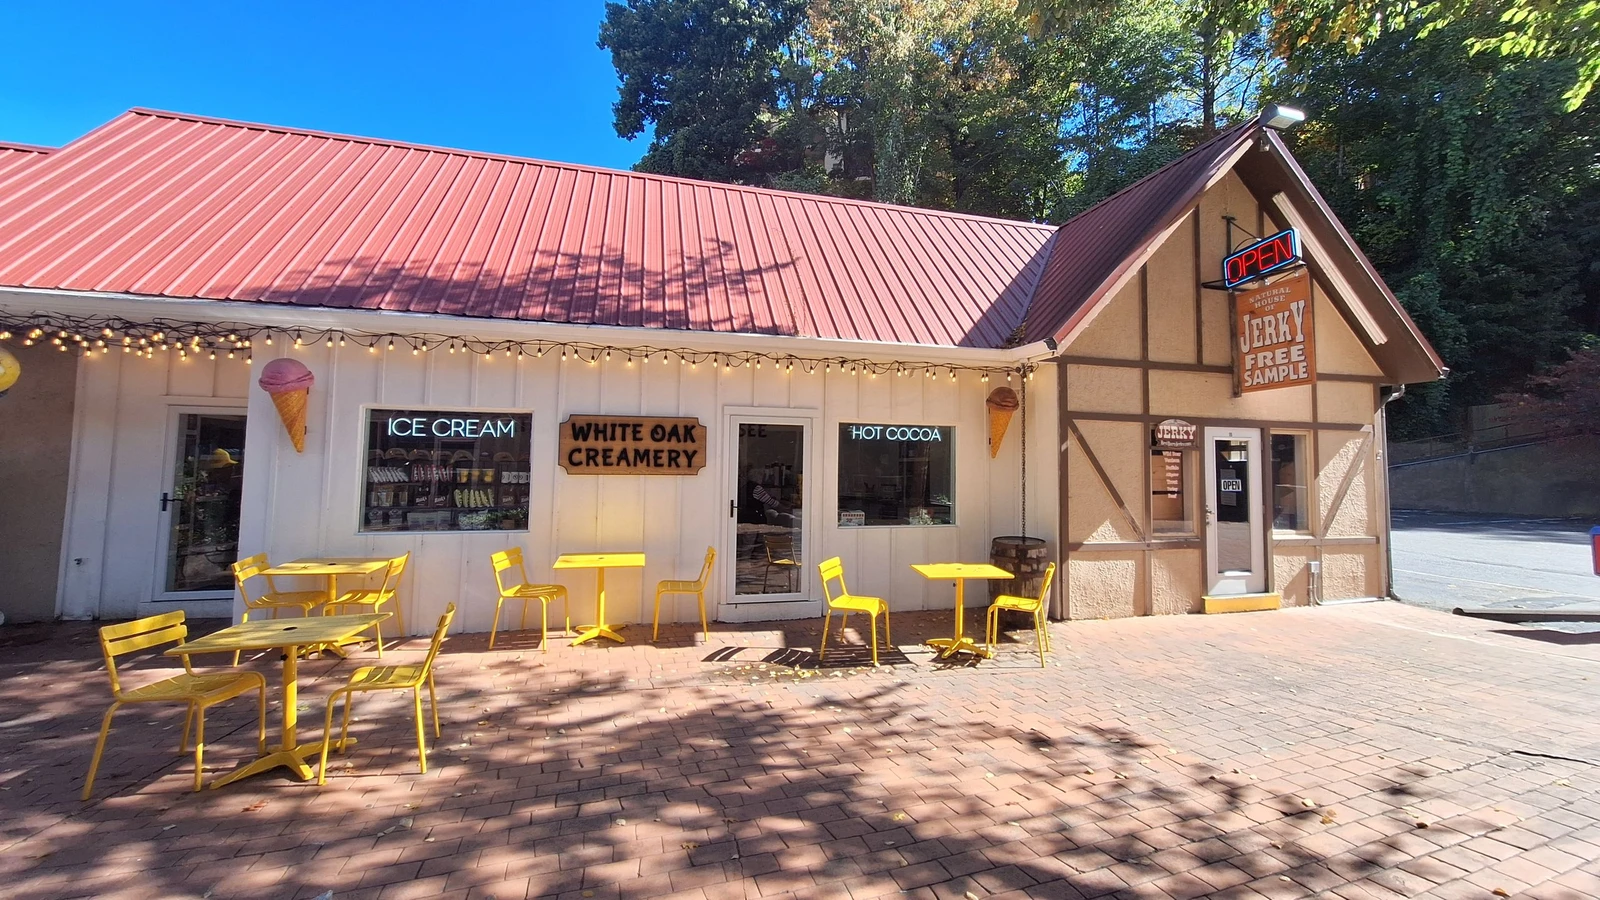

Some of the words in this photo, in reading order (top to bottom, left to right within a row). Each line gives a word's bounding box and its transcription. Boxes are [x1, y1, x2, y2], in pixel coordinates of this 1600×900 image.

[1227, 233, 1292, 282] OPEN
[1249, 287, 1291, 304] NATURAL
[1254, 295, 1286, 309] HOUSE
[1264, 304, 1276, 312] OF
[1240, 300, 1305, 353] JERKY
[1244, 345, 1305, 370] FREE
[1244, 362, 1308, 387] SAMPLE
[388, 417, 427, 437] ICE
[431, 418, 515, 438] CREAM
[571, 422, 643, 442] WHITE
[650, 424, 697, 443] OAK
[852, 425, 884, 440] HOT
[886, 426, 942, 441] COCOA
[1157, 425, 1196, 440] JERKY
[568, 447, 698, 468] CREAMERY
[1223, 480, 1240, 490] OPEN
